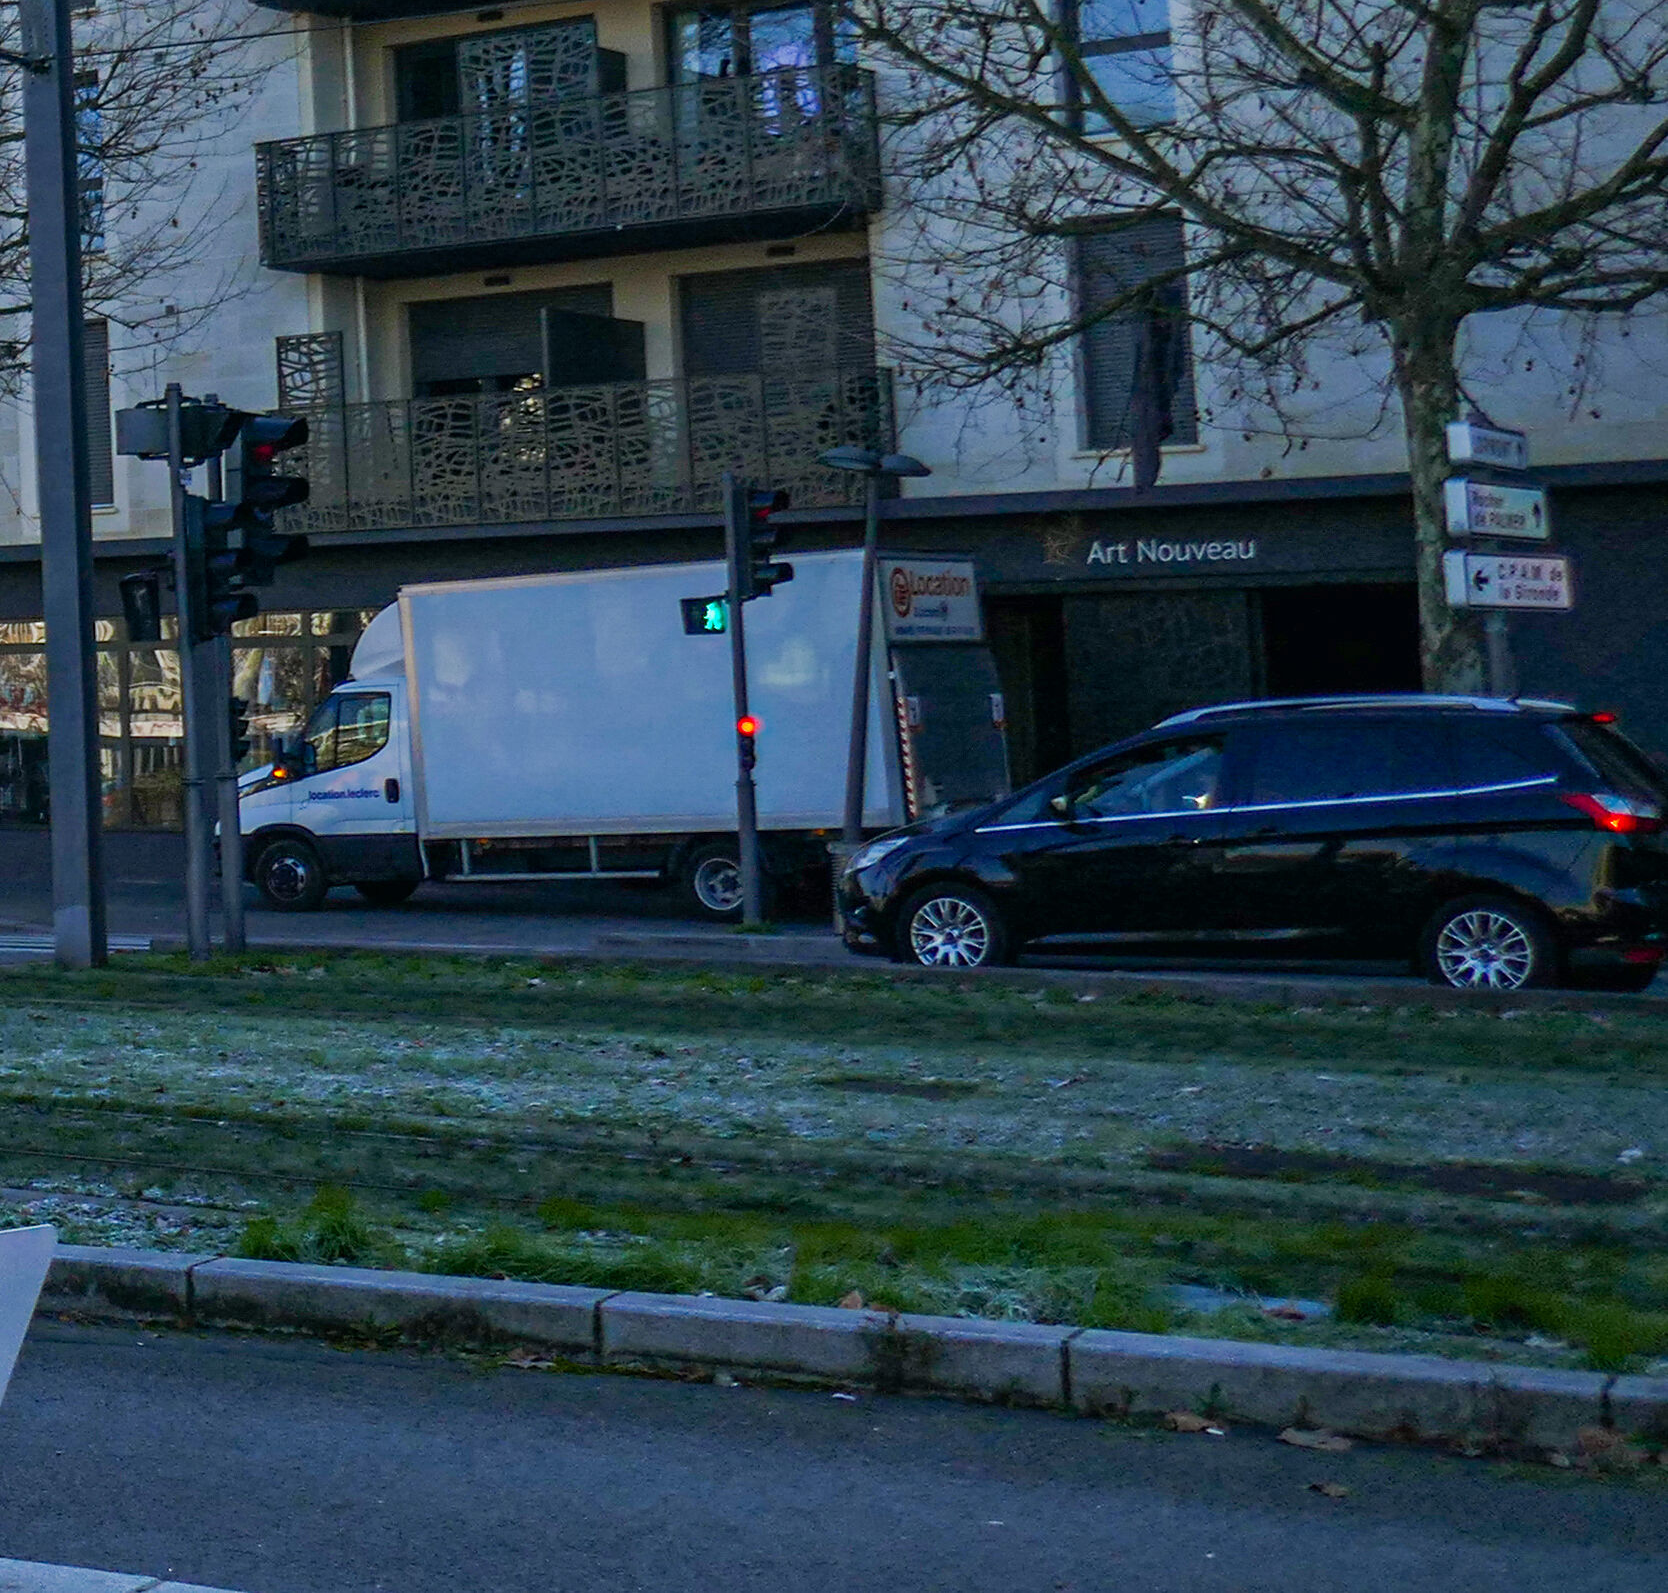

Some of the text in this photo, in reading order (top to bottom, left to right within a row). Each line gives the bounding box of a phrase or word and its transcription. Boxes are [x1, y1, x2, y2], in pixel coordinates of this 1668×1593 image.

[1086, 539, 1256, 564] Art Nouveau
[909, 569, 971, 597] Location
